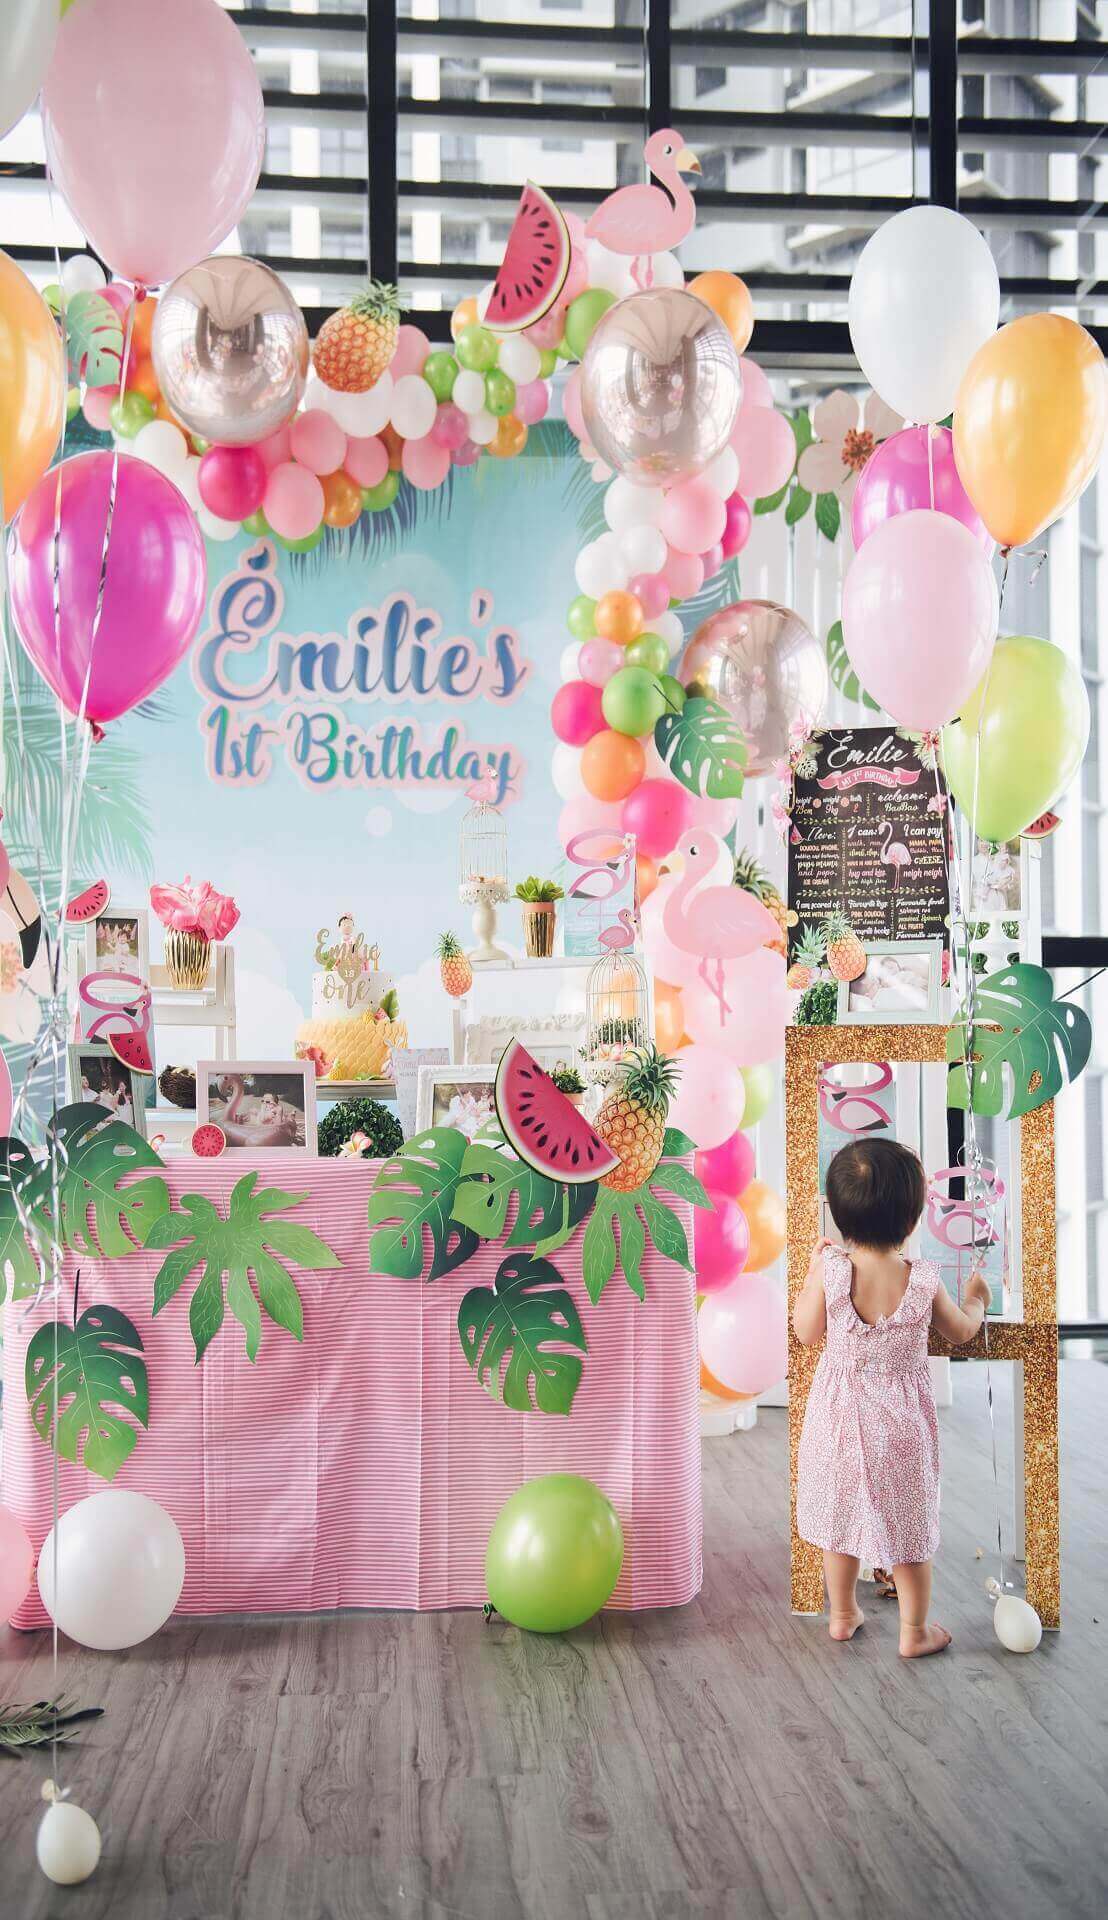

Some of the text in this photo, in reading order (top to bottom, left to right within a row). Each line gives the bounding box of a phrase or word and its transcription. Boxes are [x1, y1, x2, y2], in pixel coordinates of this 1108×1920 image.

[207, 705, 521, 805] 1st Birthday
[864, 770, 895, 786] BIRTHDAY
[878, 789, 927, 802] nickname:
[884, 803, 918, 812] BaoBao
[847, 824, 857, 839] I
[903, 823, 910, 837] I
[910, 827, 925, 836] can
[849, 869, 860, 879] hug
[861, 869, 873, 877] and
